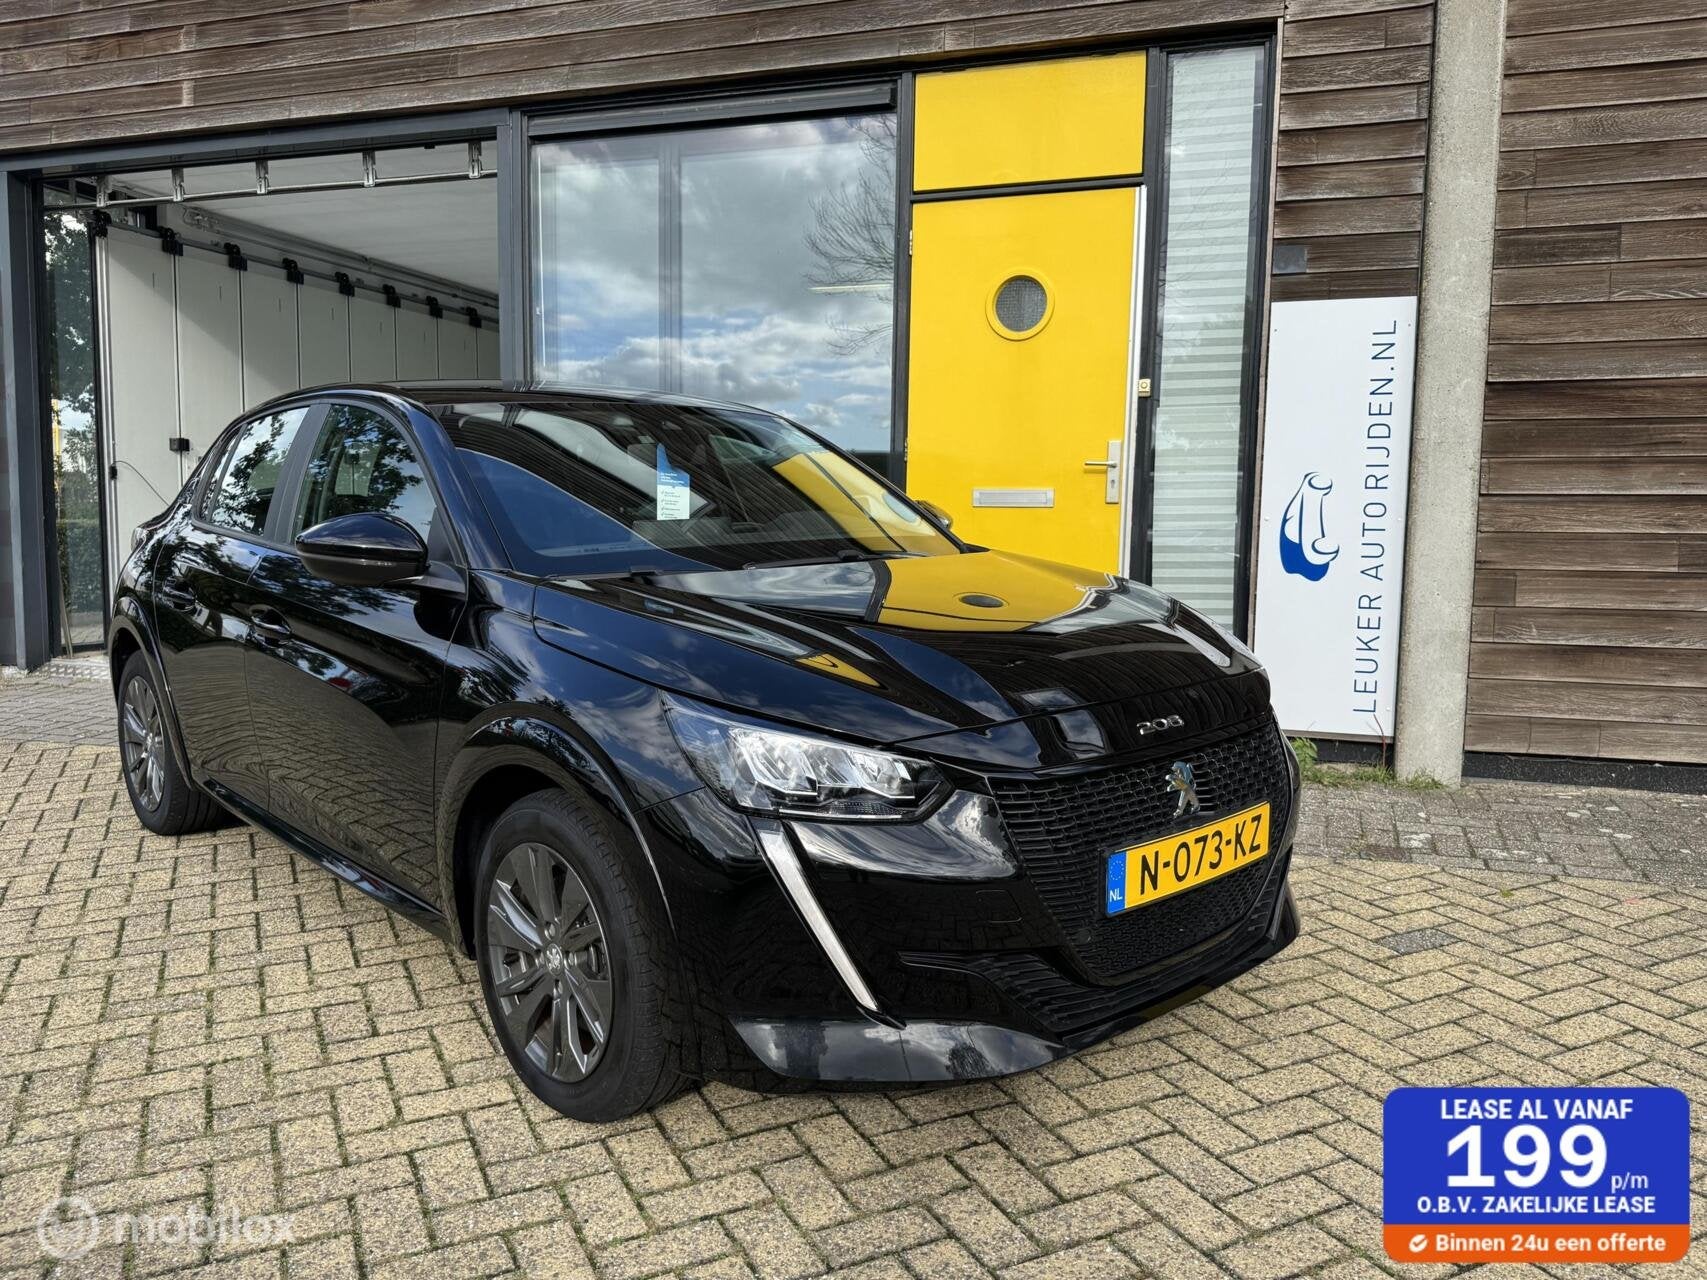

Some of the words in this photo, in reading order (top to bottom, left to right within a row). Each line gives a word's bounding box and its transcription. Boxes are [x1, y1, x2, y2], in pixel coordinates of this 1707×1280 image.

[1365, 320, 1397, 491] RIJDEN.NL
[1360, 502, 1388, 582] AUTO
[1352, 594, 1382, 714] LEUKER
[1136, 714, 1184, 735] 208
[1139, 813, 1262, 895] N-073-KZ
[1109, 888, 1123, 902] NL
